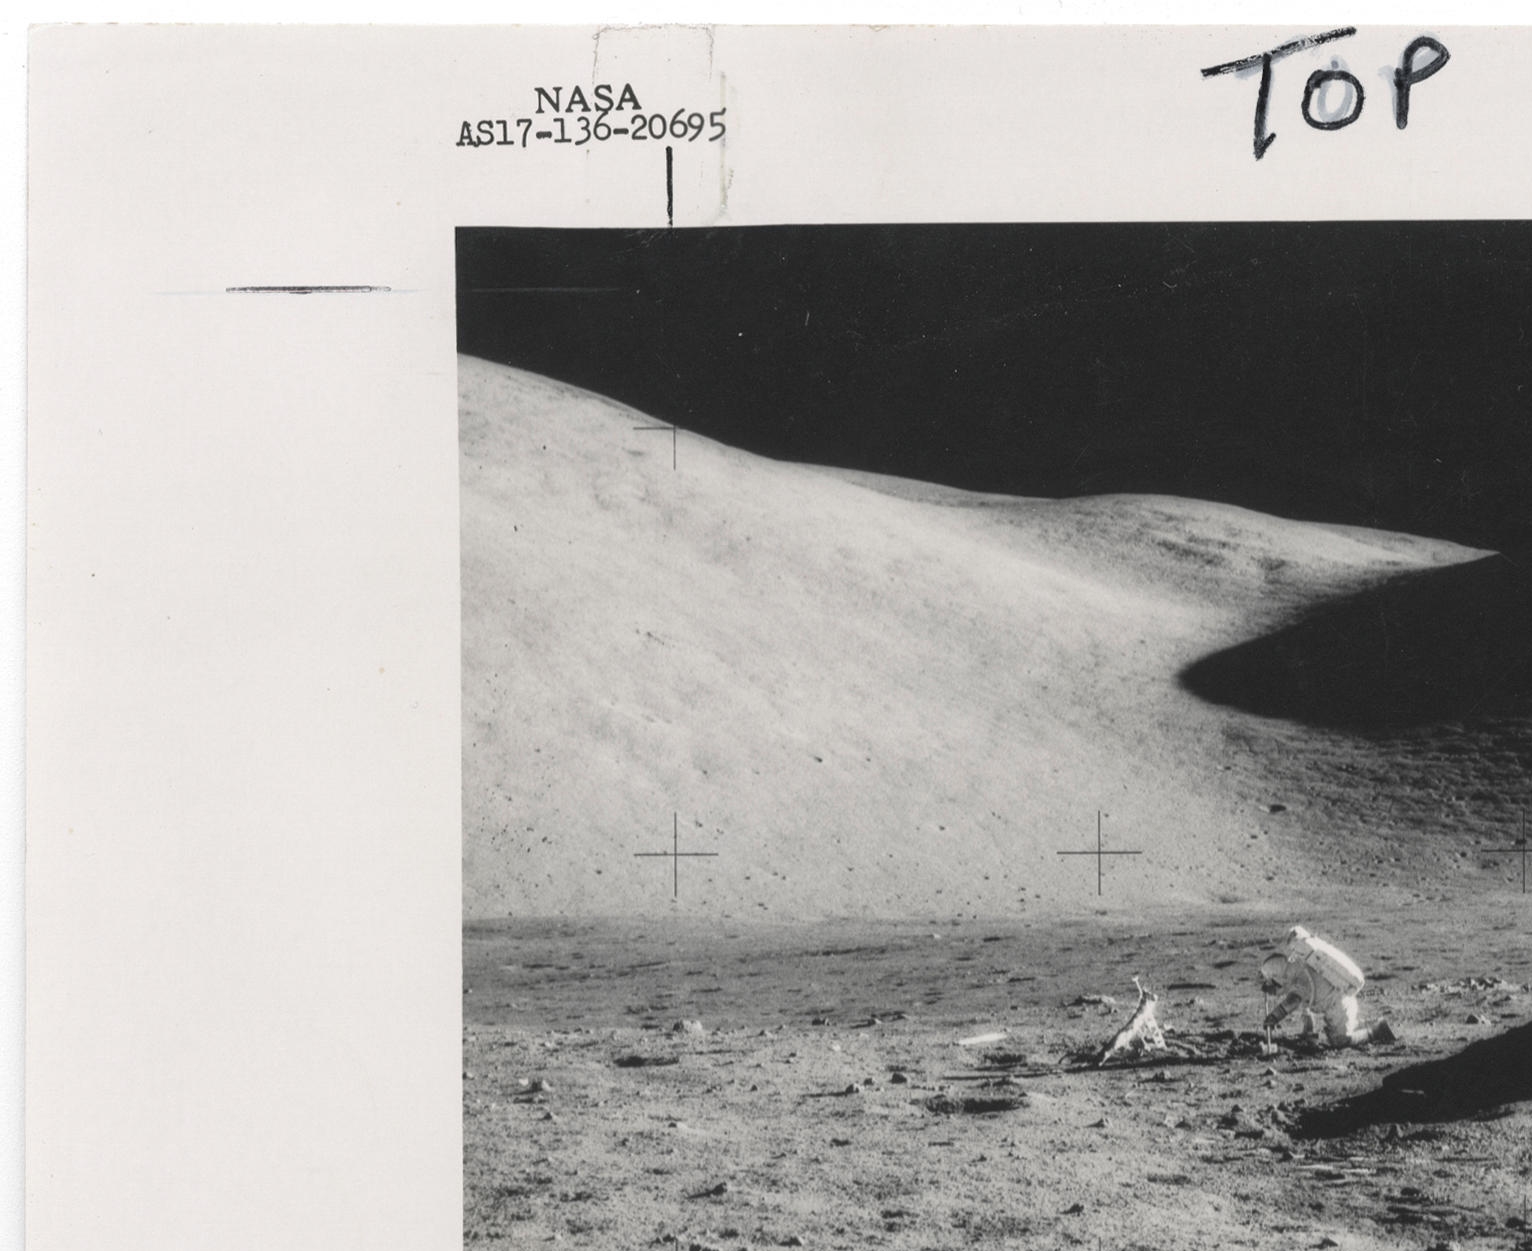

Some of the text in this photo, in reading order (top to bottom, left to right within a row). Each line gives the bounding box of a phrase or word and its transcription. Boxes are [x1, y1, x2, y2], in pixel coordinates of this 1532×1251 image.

[534, 83, 642, 113] NASA
[1200, 26, 1451, 161] TOP
[456, 107, 727, 148] AS17-136-20695
